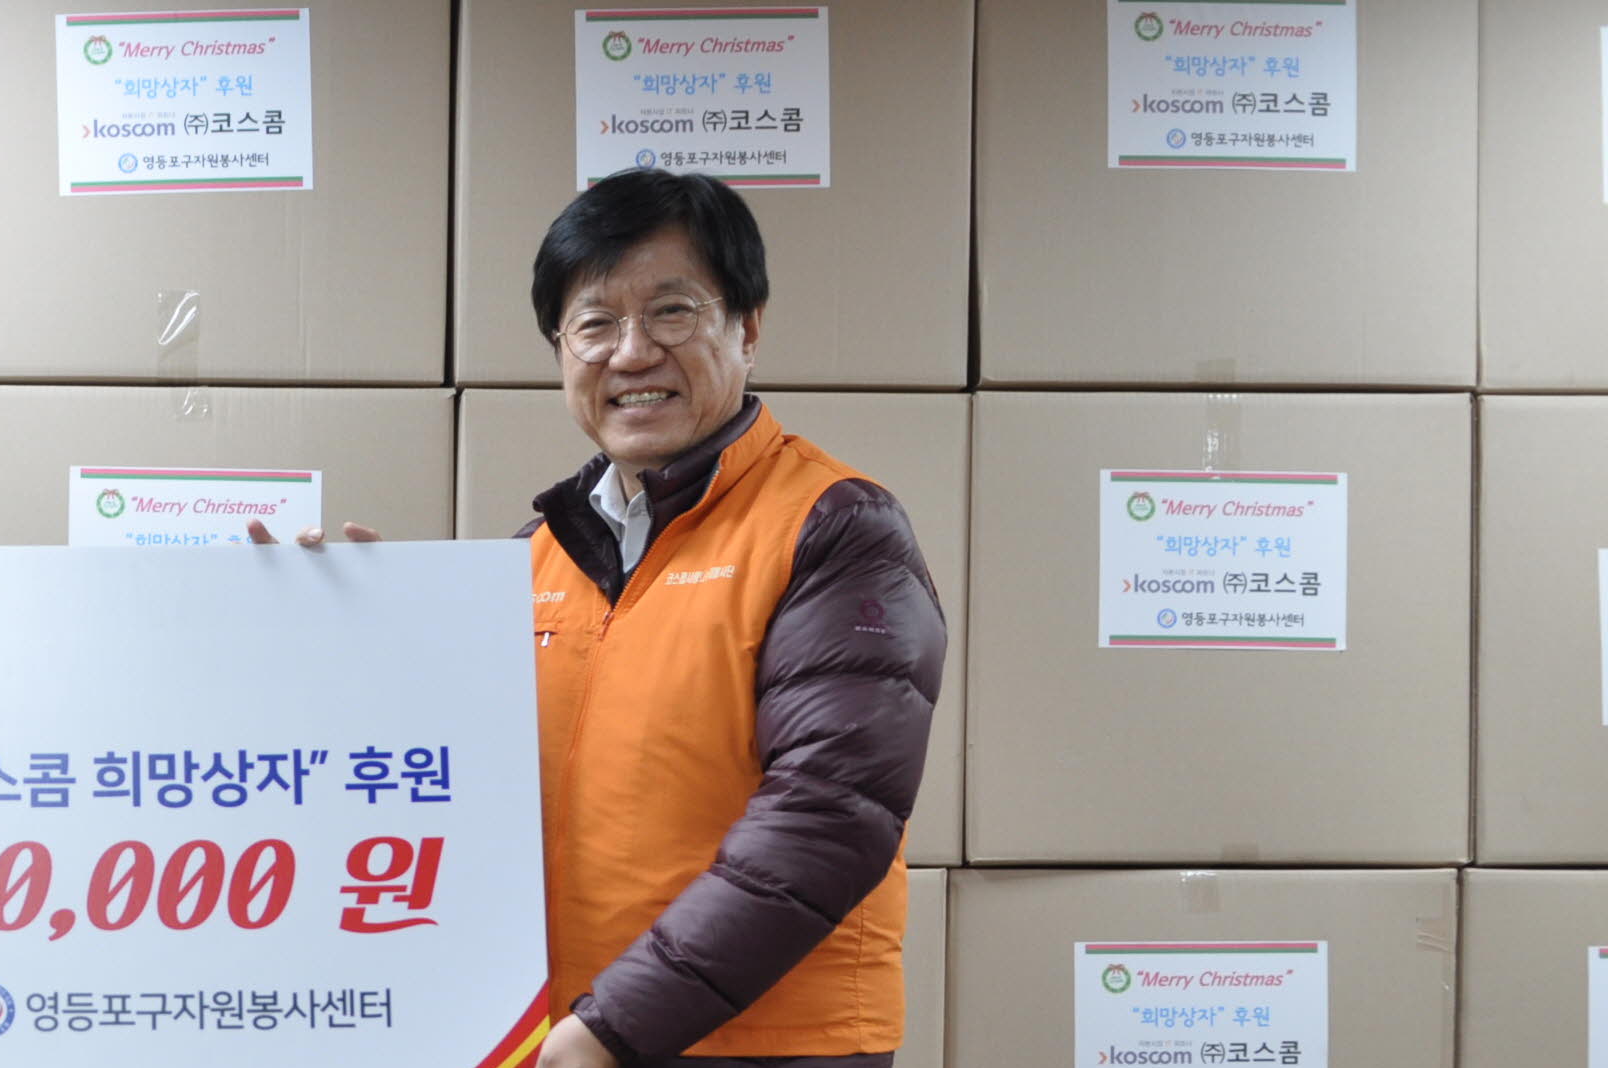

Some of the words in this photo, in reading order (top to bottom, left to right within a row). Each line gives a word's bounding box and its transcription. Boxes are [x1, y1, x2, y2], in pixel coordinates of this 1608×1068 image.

[1263, 56, 1301, 78] 후원
[215, 74, 253, 97] 후원
[733, 72, 772, 94] 후원
[1143, 93, 1224, 114] koscom
[93, 119, 176, 138] koscom
[611, 114, 694, 134] koscom
[1191, 132, 1314, 148] 영등포구자원봉사센터
[143, 152, 269, 170] 영등포구자원봉사센터
[660, 150, 787, 167] 영등포구자원봉사센터
[1255, 536, 1292, 558] 후원
[1134, 575, 1215, 595] koscom
[1181, 611, 1305, 627] 영등포구자원봉사센터
[92, 749, 329, 808] 희망상자”
[345, 746, 452, 804] 후원
[339, 836, 445, 934] 원
[26, 987, 393, 1032] 영등포구자원봉사센터
[1232, 1006, 1271, 1027] 후원
[1110, 1046, 1192, 1065] koscom
